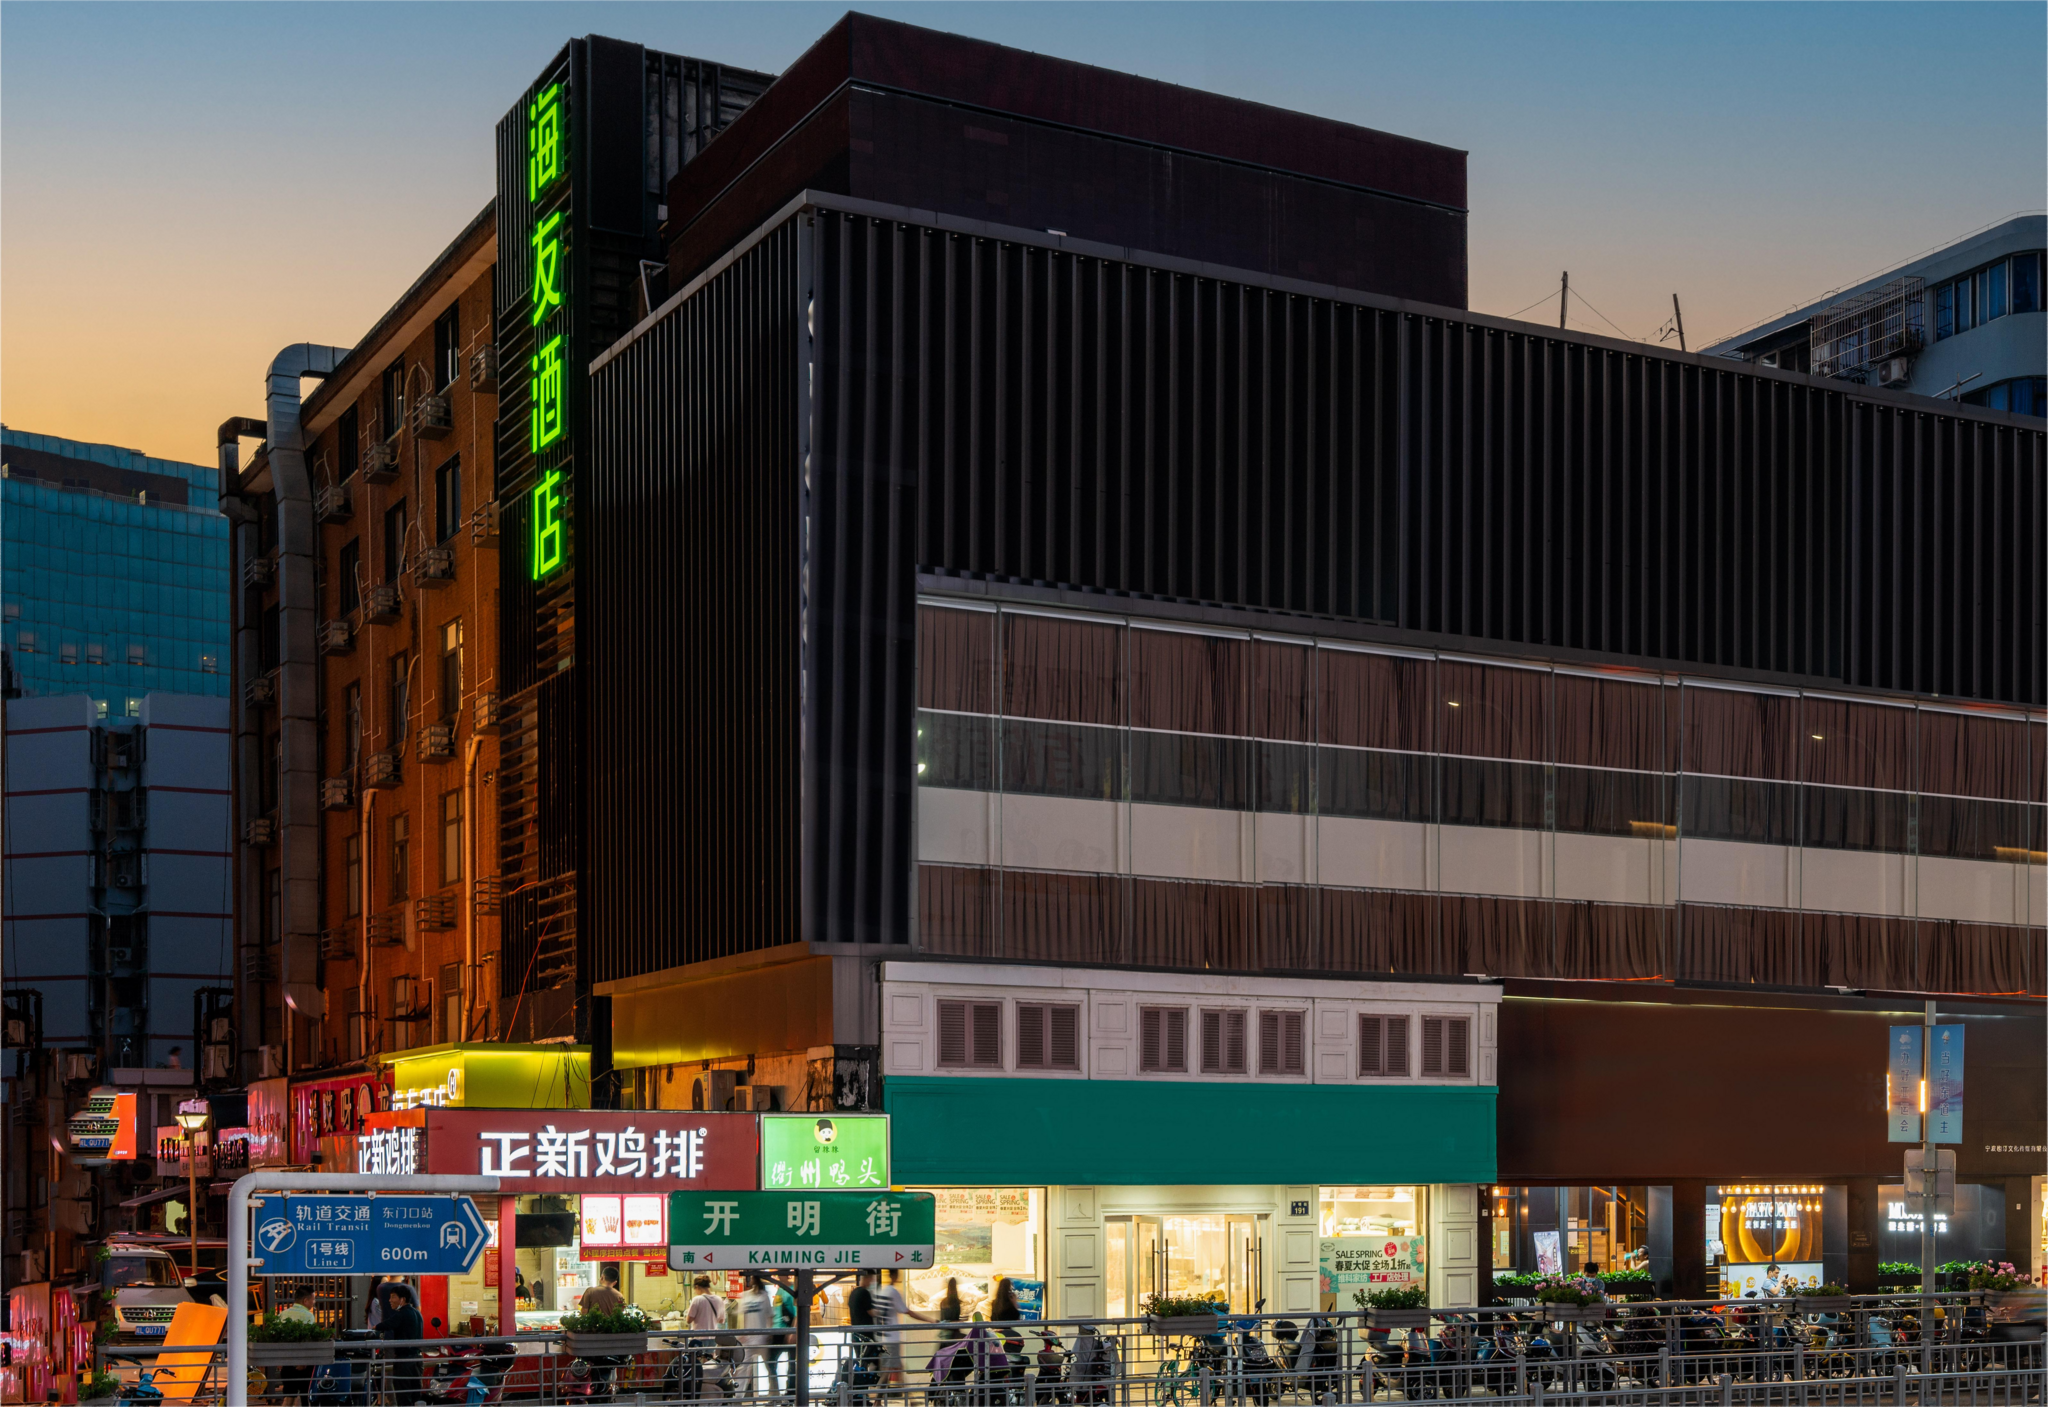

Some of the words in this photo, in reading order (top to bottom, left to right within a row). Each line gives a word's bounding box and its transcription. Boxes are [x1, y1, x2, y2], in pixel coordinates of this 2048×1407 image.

[530, 82, 564, 582] 海友酒店
[1939, 1050, 1950, 1134] 当好东道主
[359, 1127, 416, 1174] 正新鸡排
[480, 1125, 704, 1178] 正新鸡排
[295, 1205, 371, 1222] 轨道交通
[382, 1207, 433, 1219] 东门口站
[703, 1201, 902, 1237] 开明街
[297, 1222, 321, 1231] Rail
[326, 1222, 369, 1231] Transit
[310, 1242, 349, 1256] 1号线
[381, 1247, 428, 1260] 600m
[1336, 1250, 1355, 1259] SALE
[1356, 1250, 1383, 1259] SPRING
[313, 1258, 339, 1266] Line
[682, 1251, 695, 1264] 南
[749, 1250, 825, 1264] KAIMING
[834, 1250, 861, 1264] JIE
[910, 1251, 923, 1263] 北
[1335, 1260, 1371, 1271] 春夏大促
